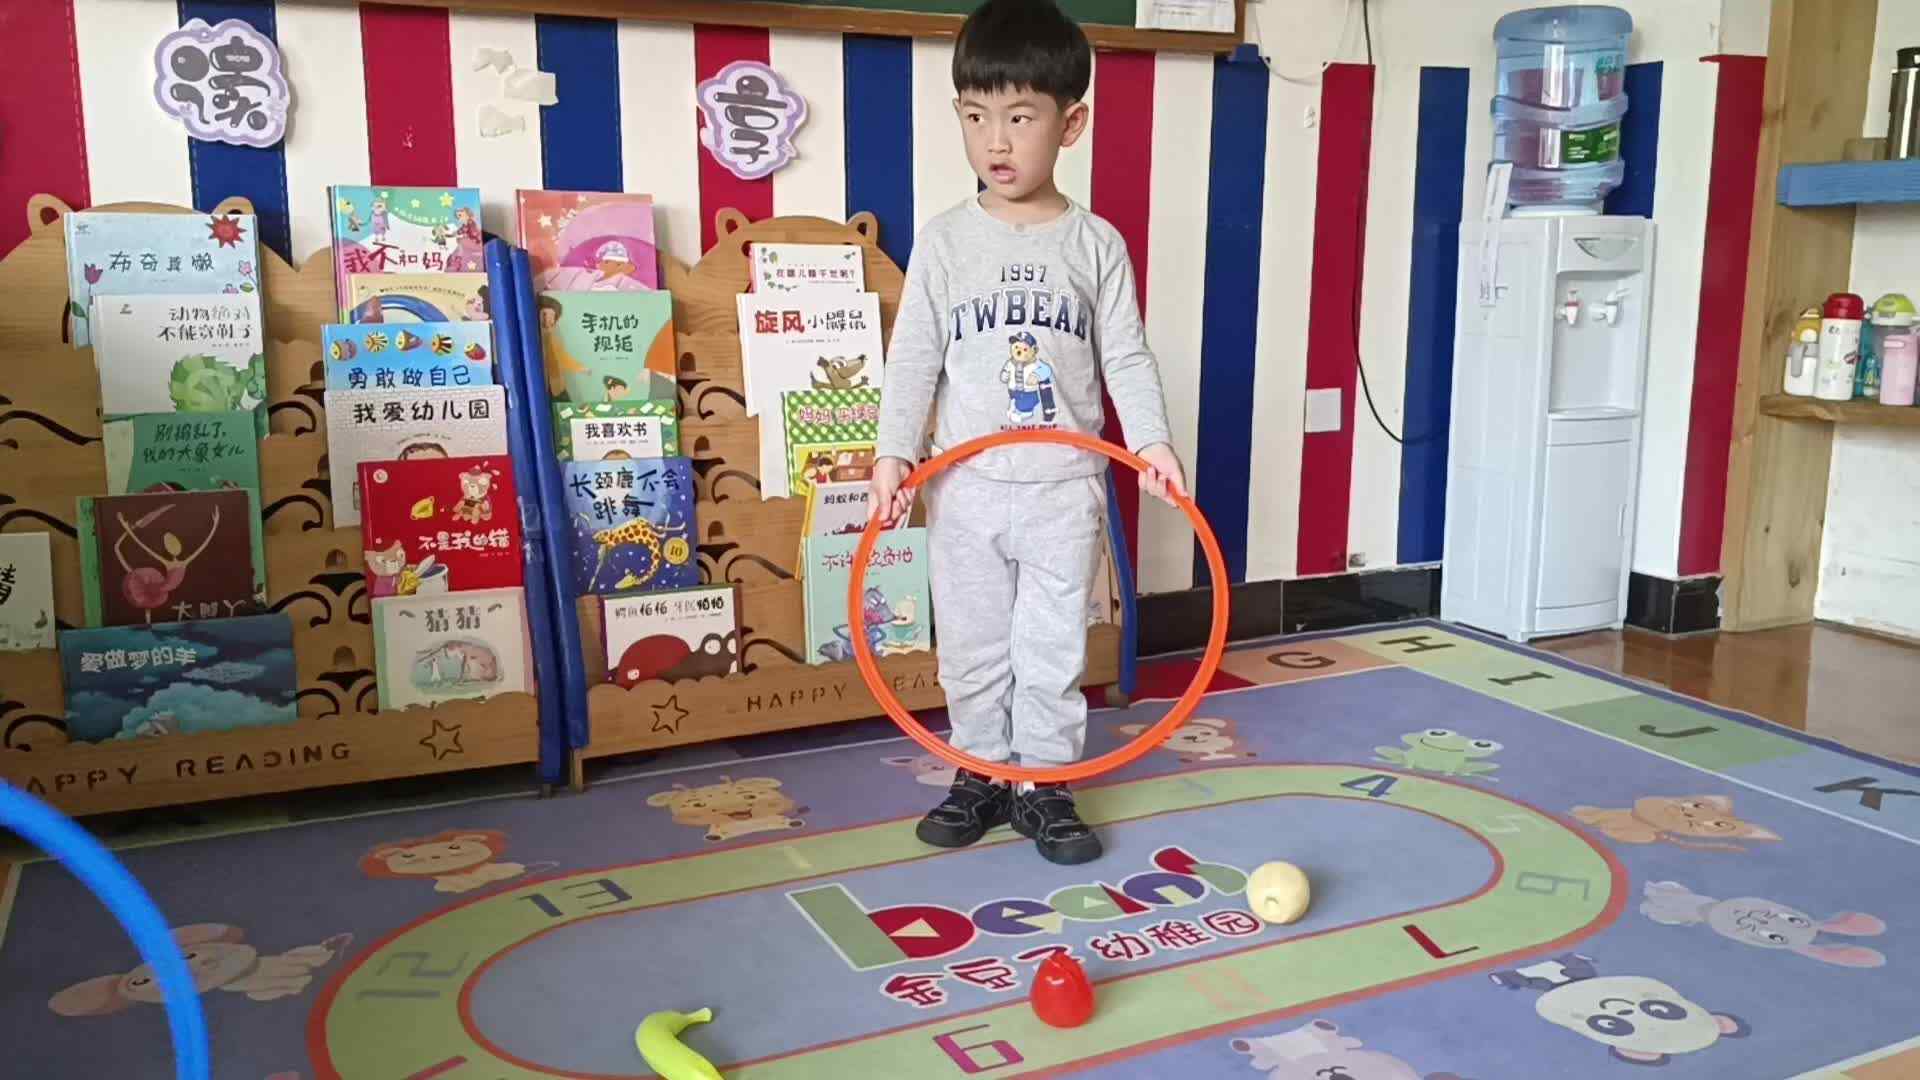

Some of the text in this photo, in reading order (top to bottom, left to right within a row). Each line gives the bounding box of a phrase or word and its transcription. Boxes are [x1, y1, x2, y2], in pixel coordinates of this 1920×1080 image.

[1000, 264, 1048, 283] 1997
[581, 312, 640, 334] 手机的
[754, 309, 867, 334] 旋风小鼹鼠
[593, 334, 634, 353] 规矩
[347, 364, 472, 389] 勇敢做自己
[353, 398, 490, 424] 我爱幼儿园
[584, 422, 648, 439] 我喜欢书
[569, 466, 681, 500] 长颈鹿不会
[592, 493, 655, 524] 跳舞
[417, 528, 511, 551] 不是我的猫
[424, 605, 481, 633] 猜猜
[1378, 634, 1456, 658] H
[80, 646, 197, 673] 爱做梦的羊
[1267, 651, 1337, 671] G
[1489, 670, 1553, 688] I
[746, 684, 848, 712] HAPPY
[1639, 723, 1719, 745] J
[26, 742, 352, 797] APPY READING
[1340, 774, 1400, 798] 4
[1814, 777, 1920, 811] K
